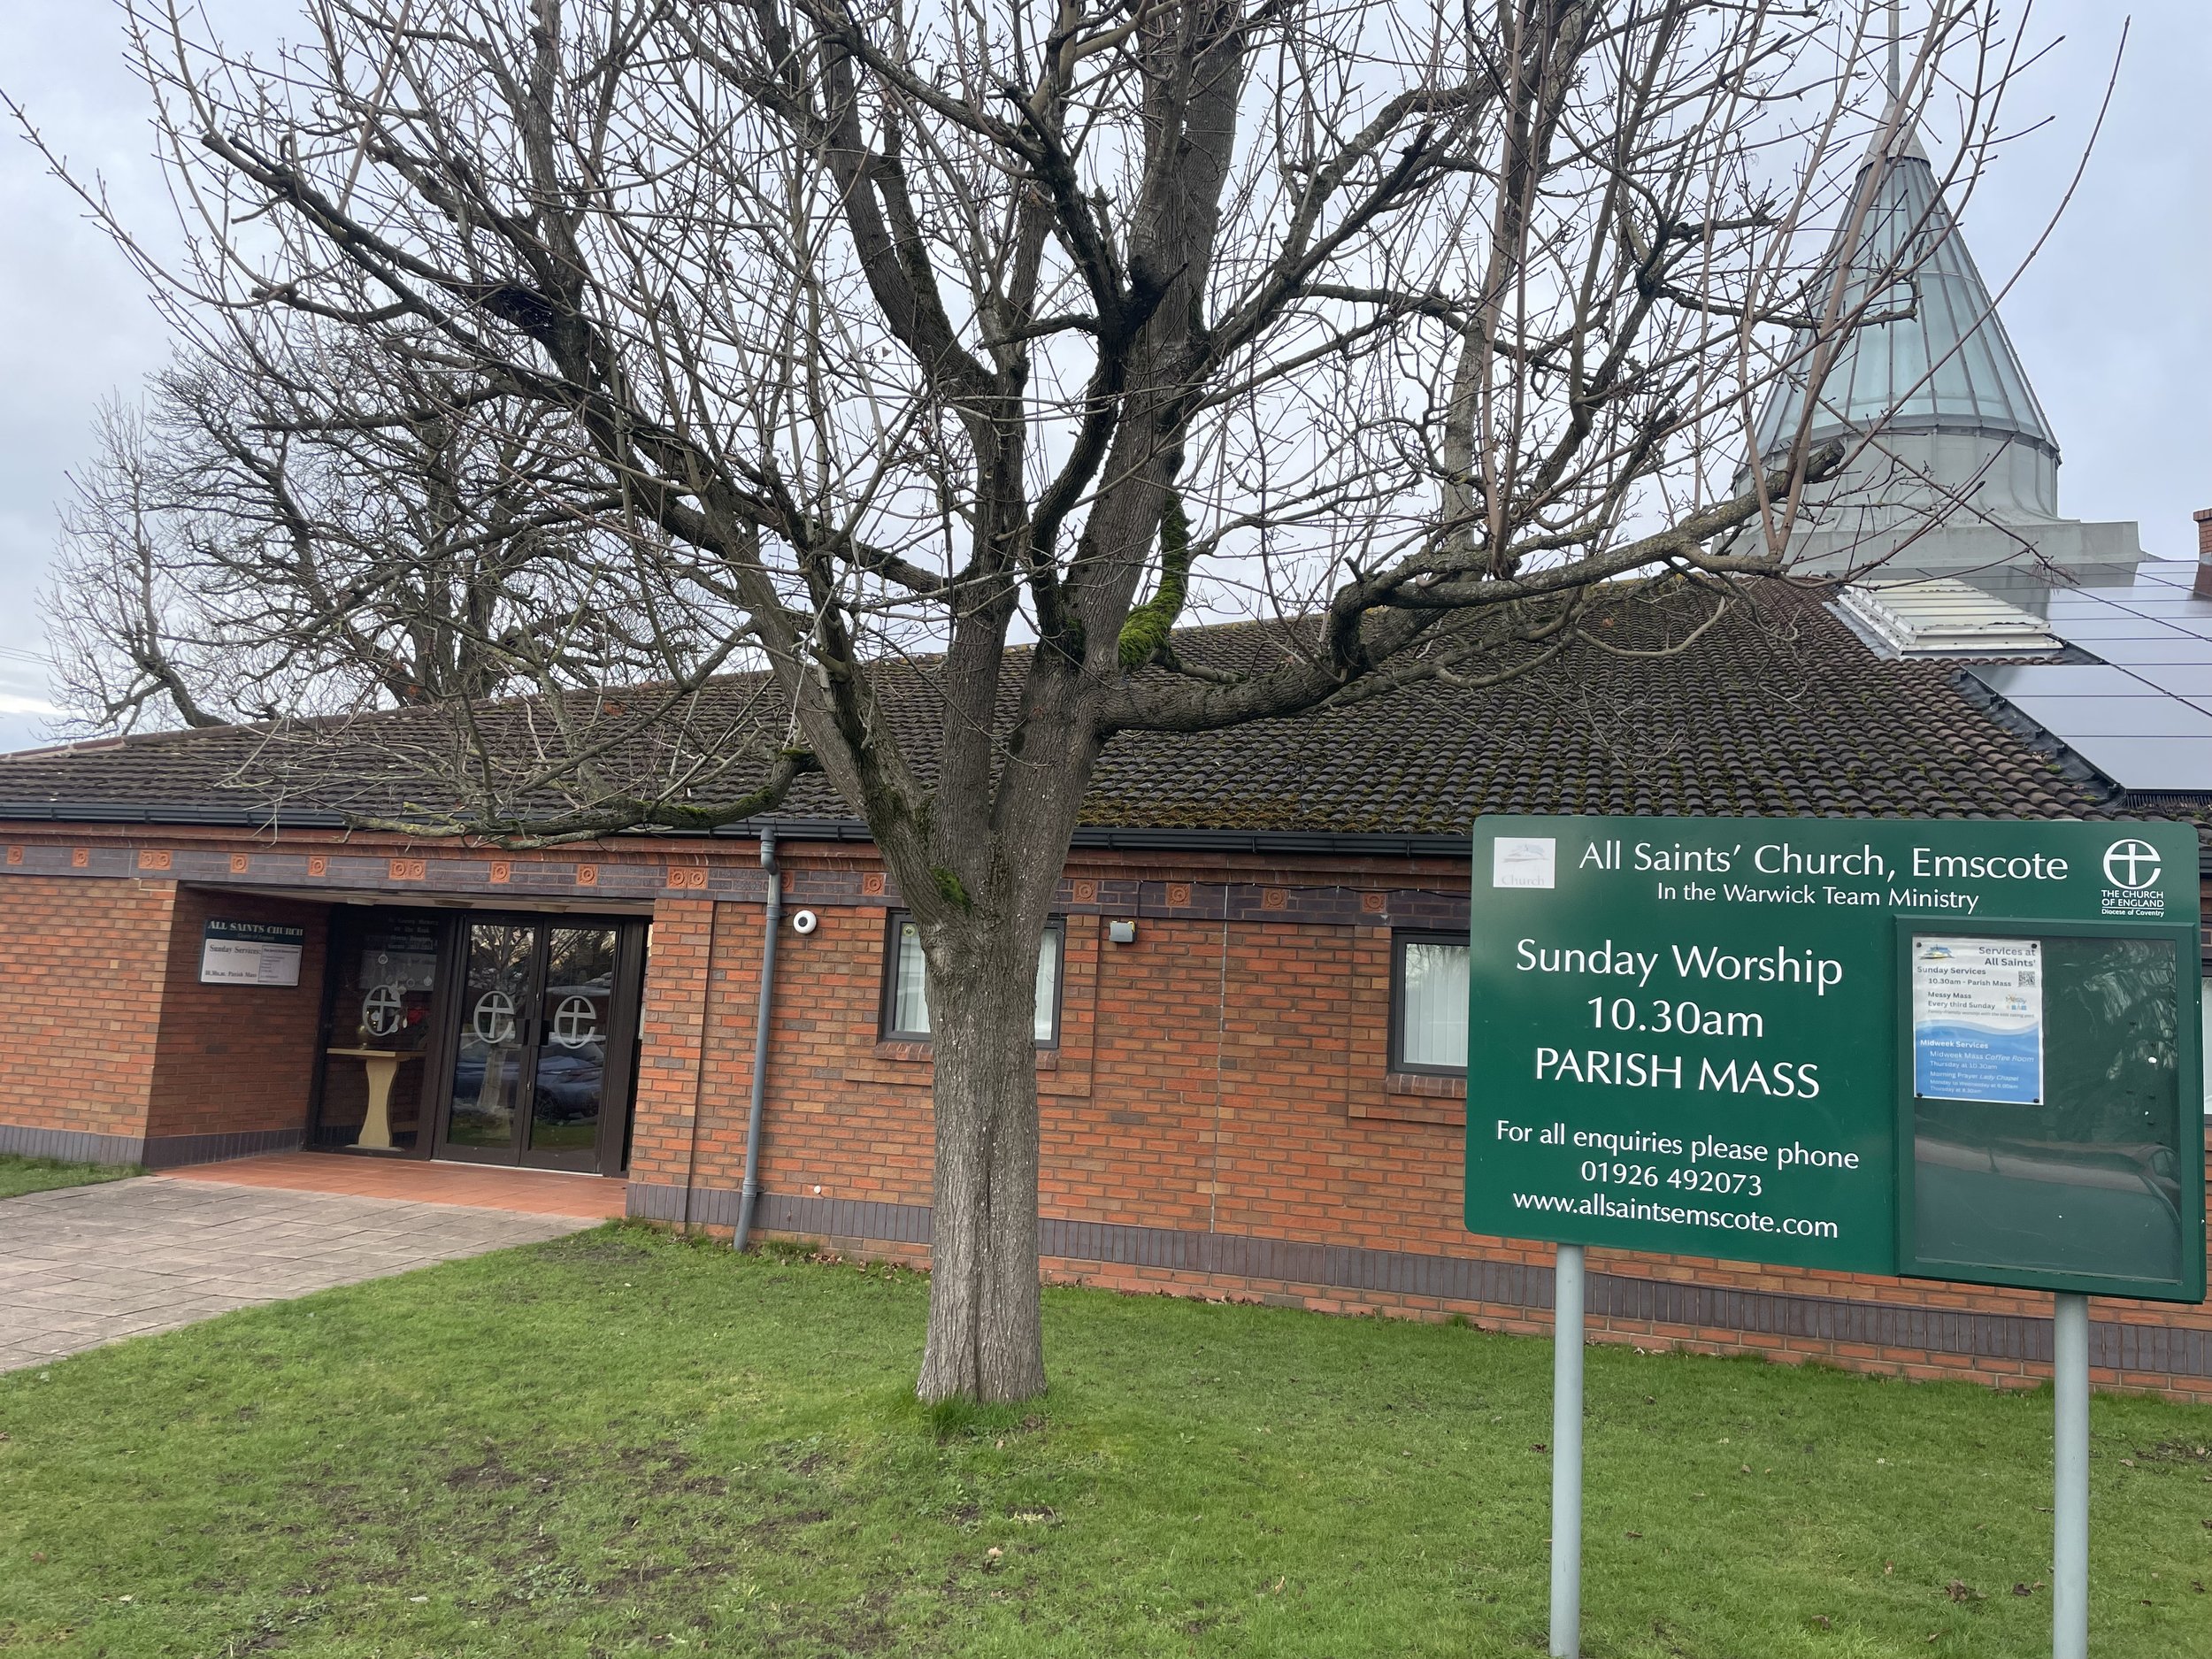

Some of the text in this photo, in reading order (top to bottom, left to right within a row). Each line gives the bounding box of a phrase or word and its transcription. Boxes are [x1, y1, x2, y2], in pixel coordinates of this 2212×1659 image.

[1578, 840, 2069, 883] All Saints' Church, Emscote
[1658, 881, 1979, 915] In the Warwick Team Ministry
[2122, 890, 2163, 899] CHURCH
[2117, 899, 2164, 908] ENGLAND
[207, 920, 303, 936] ALL SAINTS CHURCH
[209, 944, 232, 954] Sunday
[1978, 946, 2036, 956] Services at
[1515, 938, 1843, 996] Sunday Worship
[1984, 957, 1999, 966] All
[1916, 966, 1948, 975] Sunday
[1967, 978, 1991, 987] Parish
[1927, 991, 1952, 1000] Messy
[1949, 1000, 1968, 1009] third
[1969, 1001, 1996, 1010] Sunday
[1587, 996, 1763, 1038] 10.30am
[1919, 1039, 1989, 1049] Midweek Services
[1930, 1050, 1962, 1059] Midweek
[1985, 1053, 2011, 1062] Coffee
[1930, 1061, 1961, 1070] Thursday
[1536, 1047, 1820, 1099] PARISH MASS
[1930, 1071, 1956, 1079] Morning
[1979, 1073, 1995, 1082] Lady
[1996, 1074, 2019, 1083] Chapel
[1497, 1119, 1859, 1171] For all enquiries please phone
[1581, 1160, 1763, 1196] 01926 492073
[1512, 1193, 1838, 1239] www.allsaintsemscote.com
